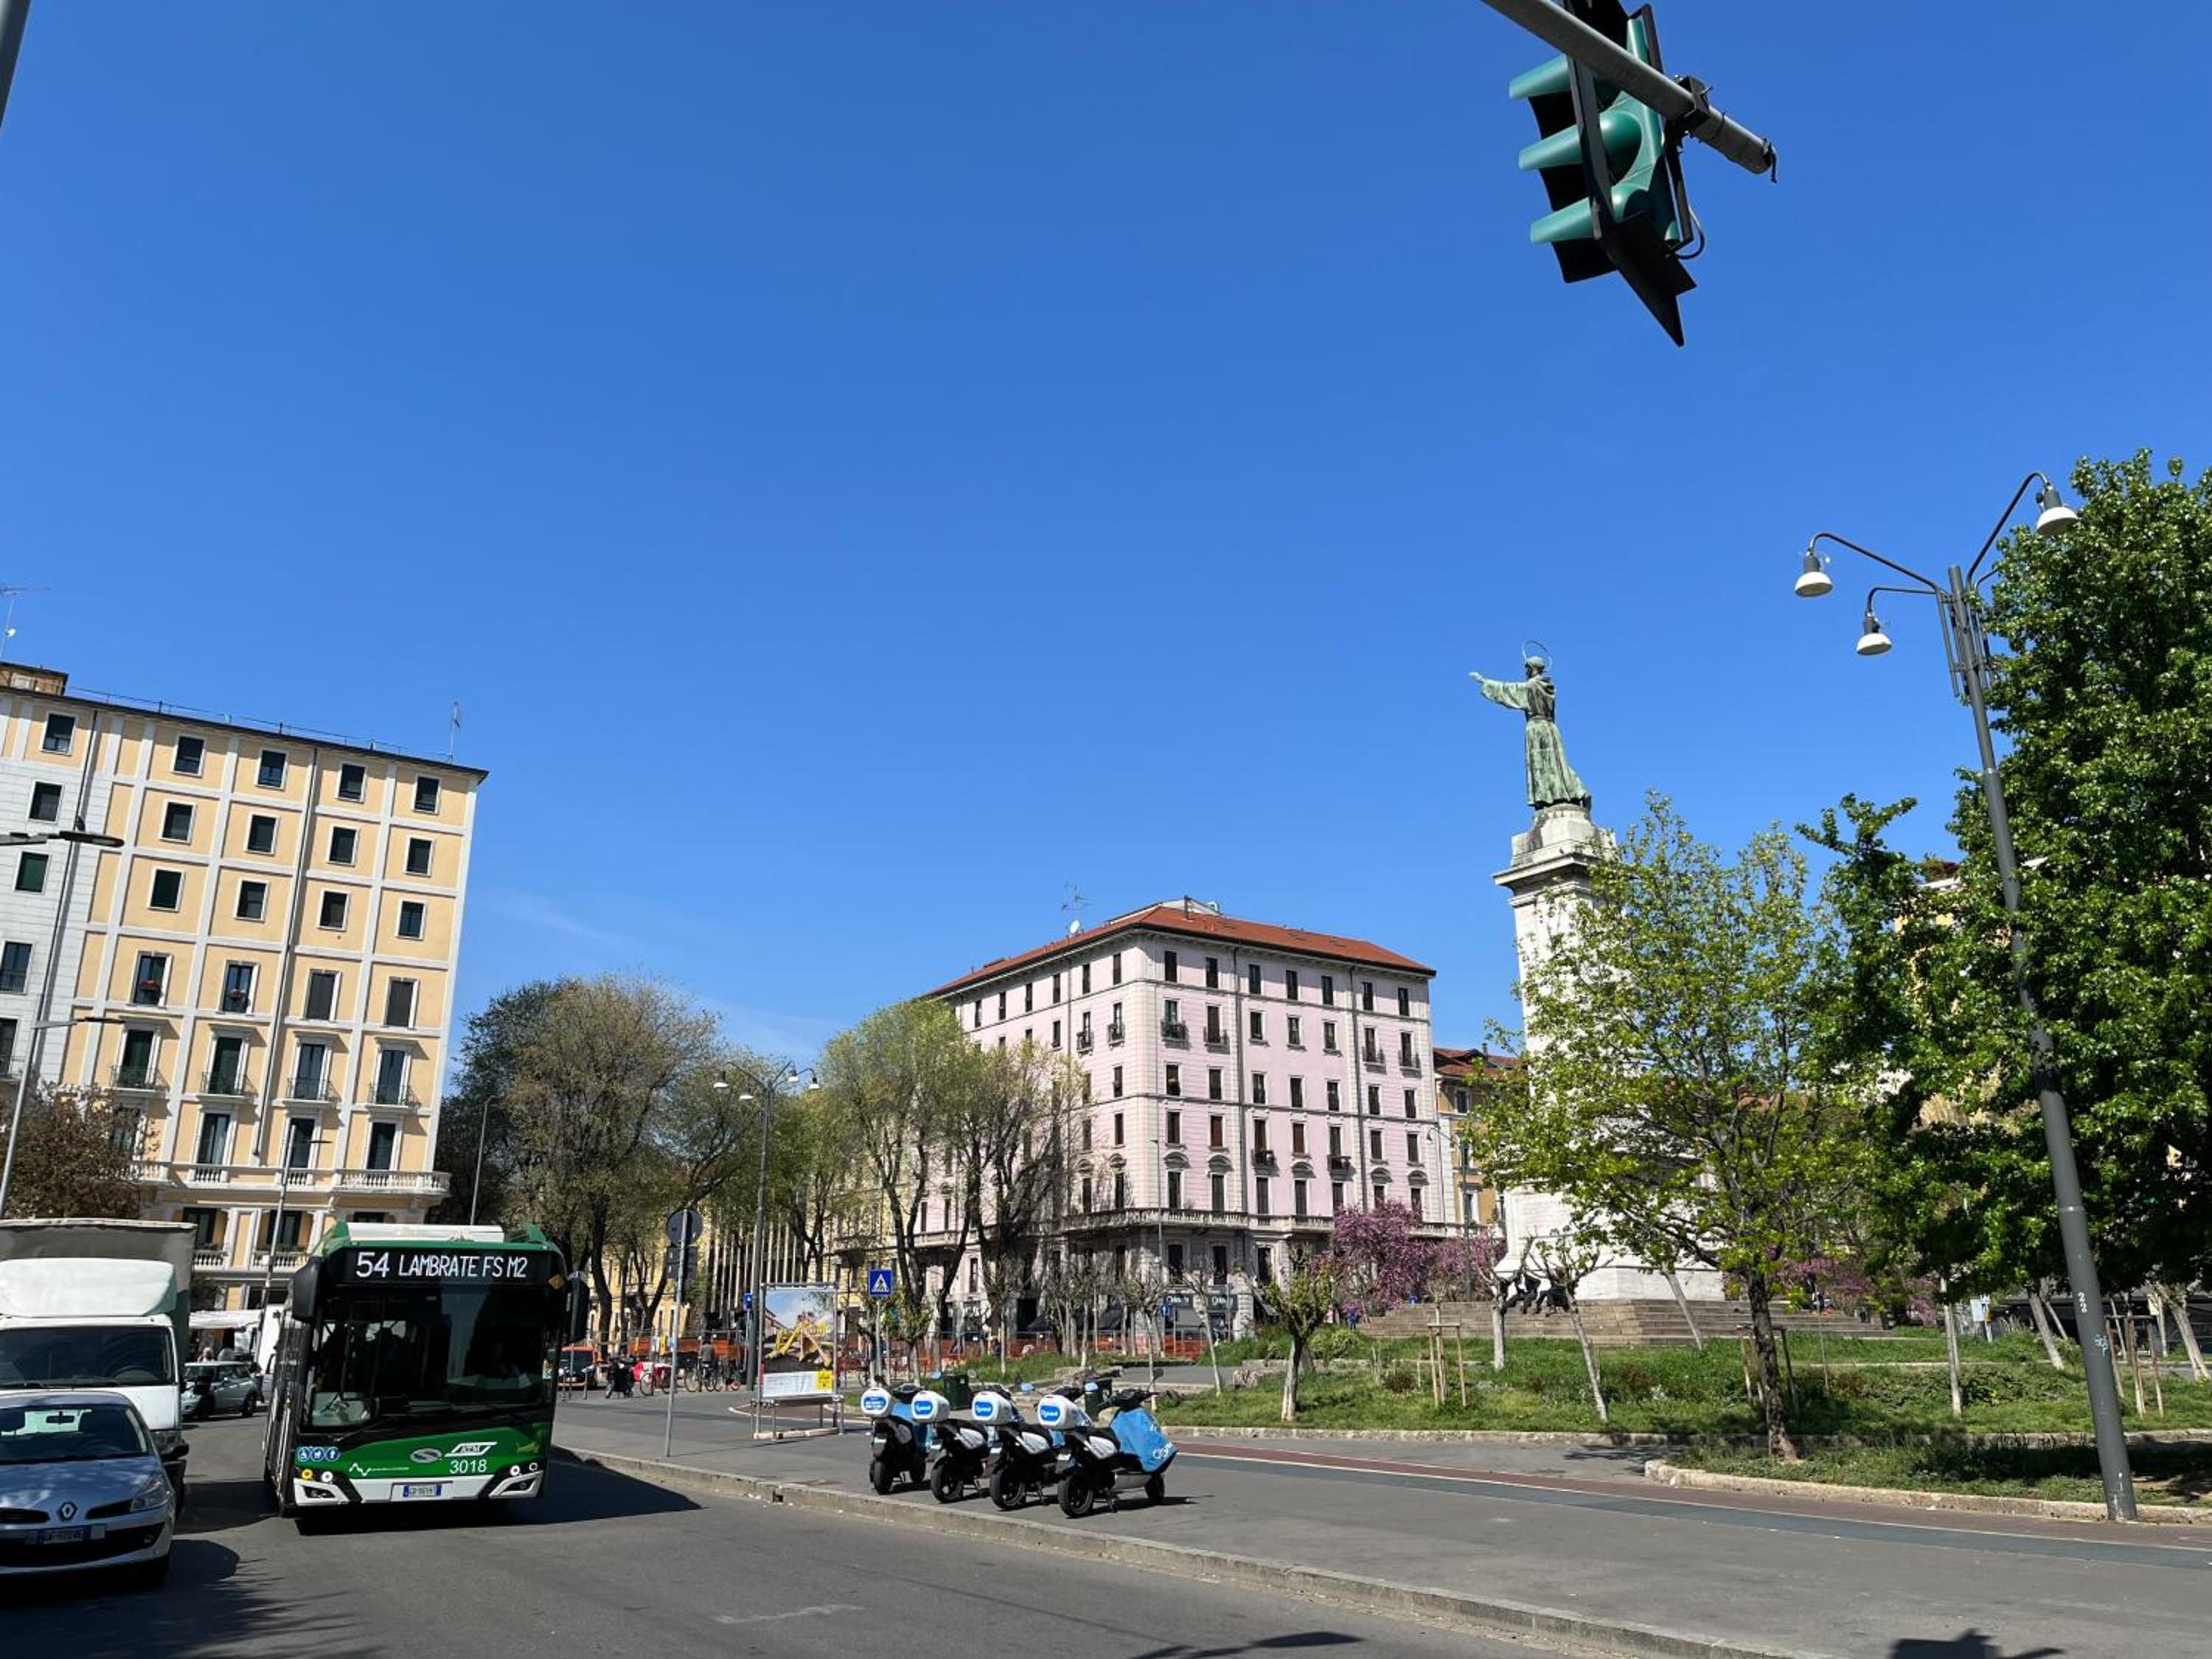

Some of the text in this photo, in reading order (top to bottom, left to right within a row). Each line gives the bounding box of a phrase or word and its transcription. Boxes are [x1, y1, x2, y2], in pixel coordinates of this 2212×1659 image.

[356, 1252, 528, 1277] 54 LAMBRATE FS M2
[449, 1459, 487, 1474] 3018
